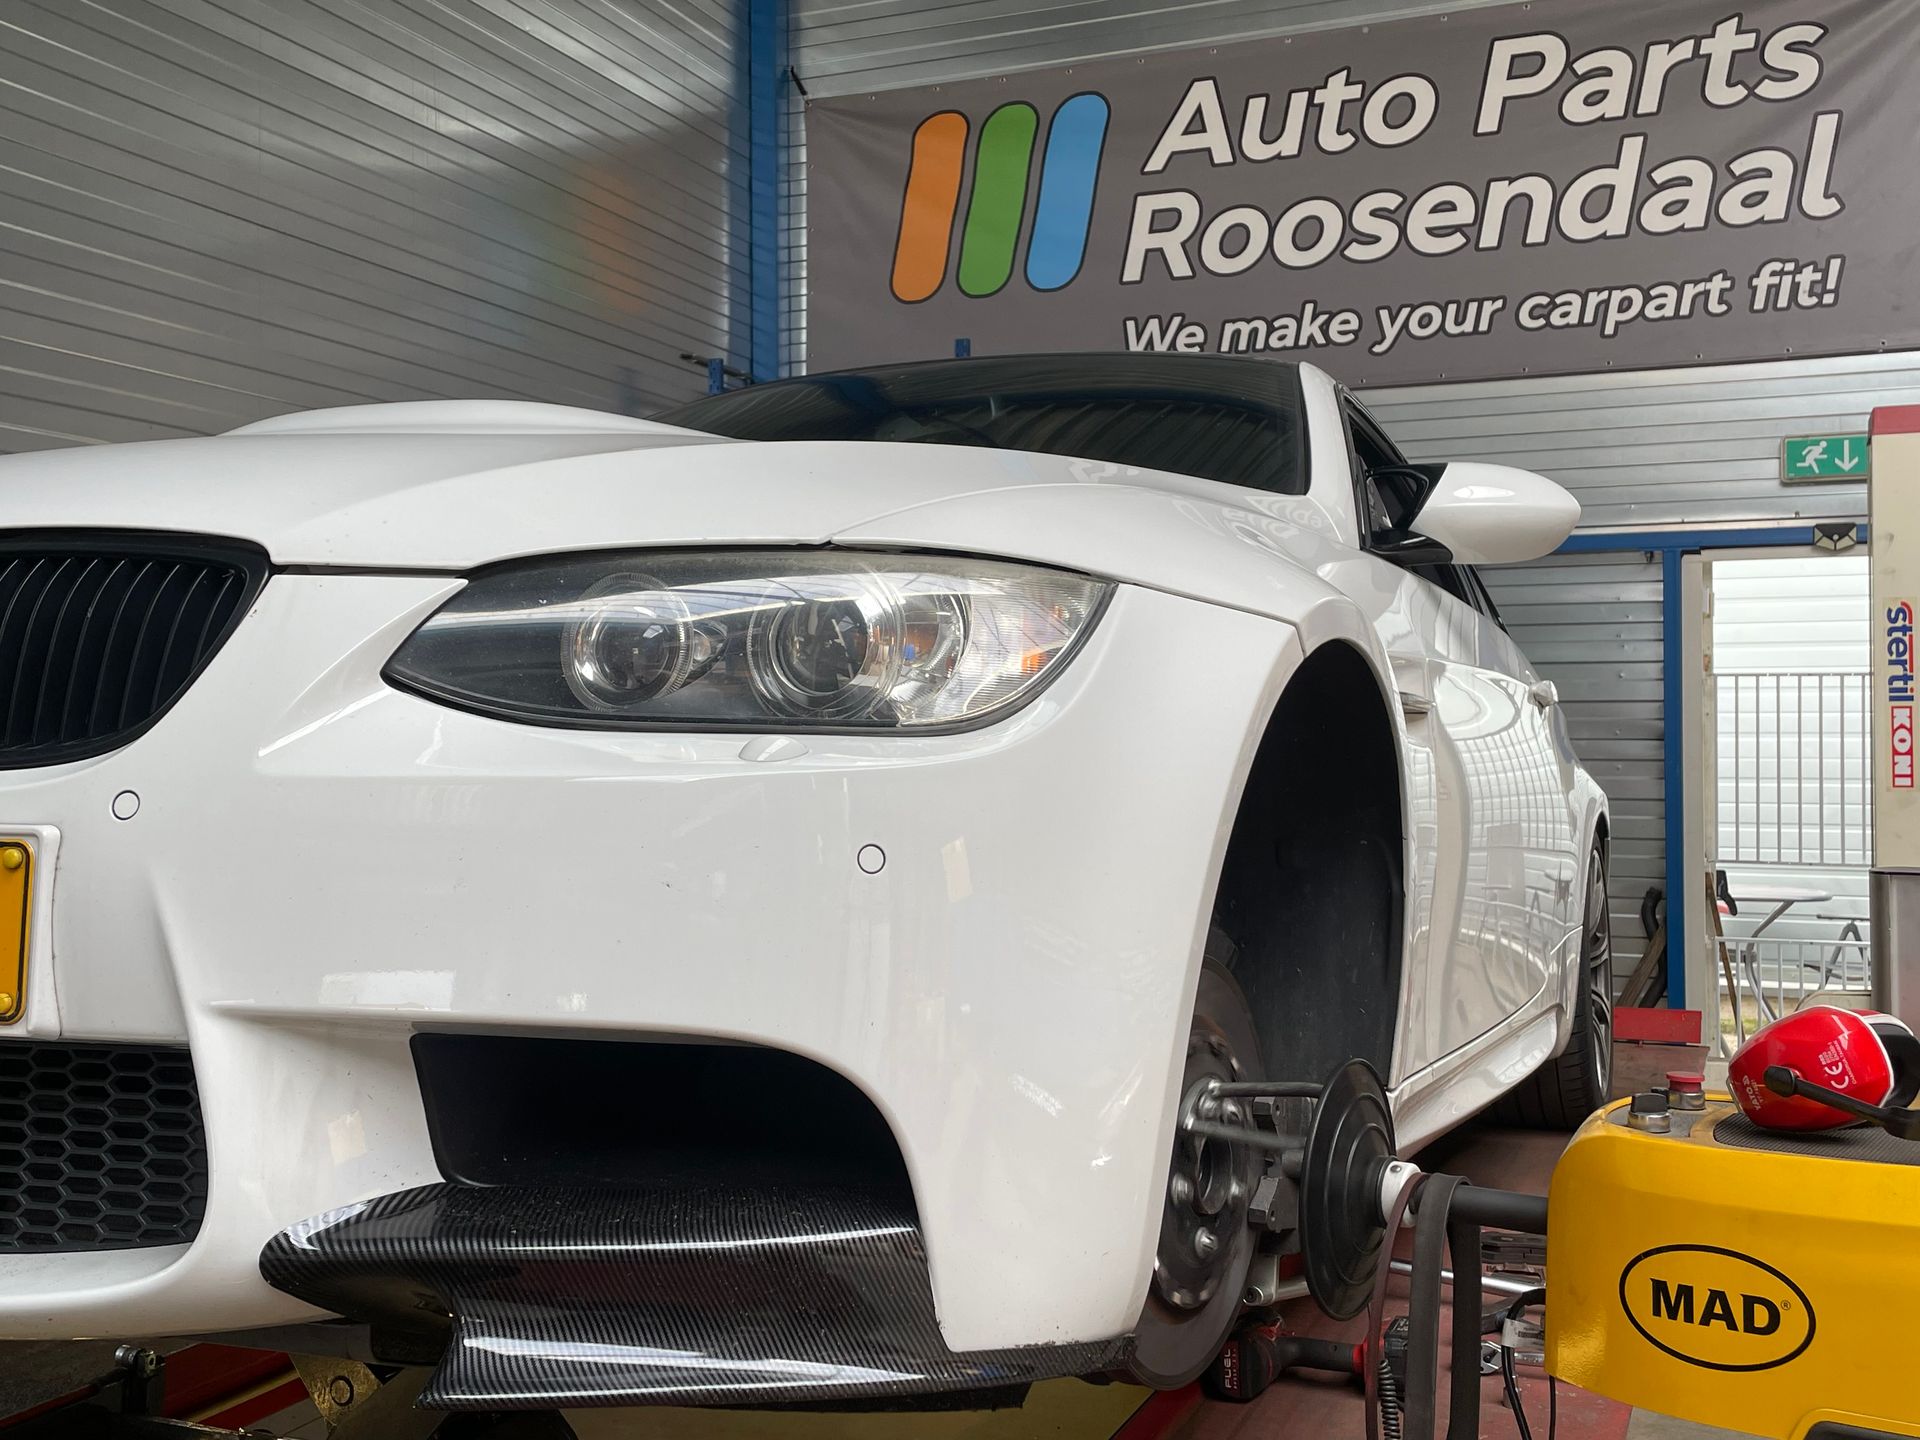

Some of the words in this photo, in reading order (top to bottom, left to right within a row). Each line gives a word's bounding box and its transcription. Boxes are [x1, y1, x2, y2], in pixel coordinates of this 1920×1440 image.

[1141, 66, 1439, 174] Auto
[1473, 12, 1829, 136] Parts
[1120, 110, 1845, 284] Roosendaal
[1124, 314, 1207, 351] We
[1218, 301, 1362, 353] make
[1369, 295, 1506, 355] your
[1516, 269, 1735, 338] carpart
[1749, 254, 1845, 313] fit!
[1886, 605, 1914, 702] stertil
[1892, 707, 1913, 787] KONI
[1745, 1083, 1761, 1110] YATO
[1825, 1062, 1849, 1089] CE
[1223, 1348, 1232, 1389] FUEL
